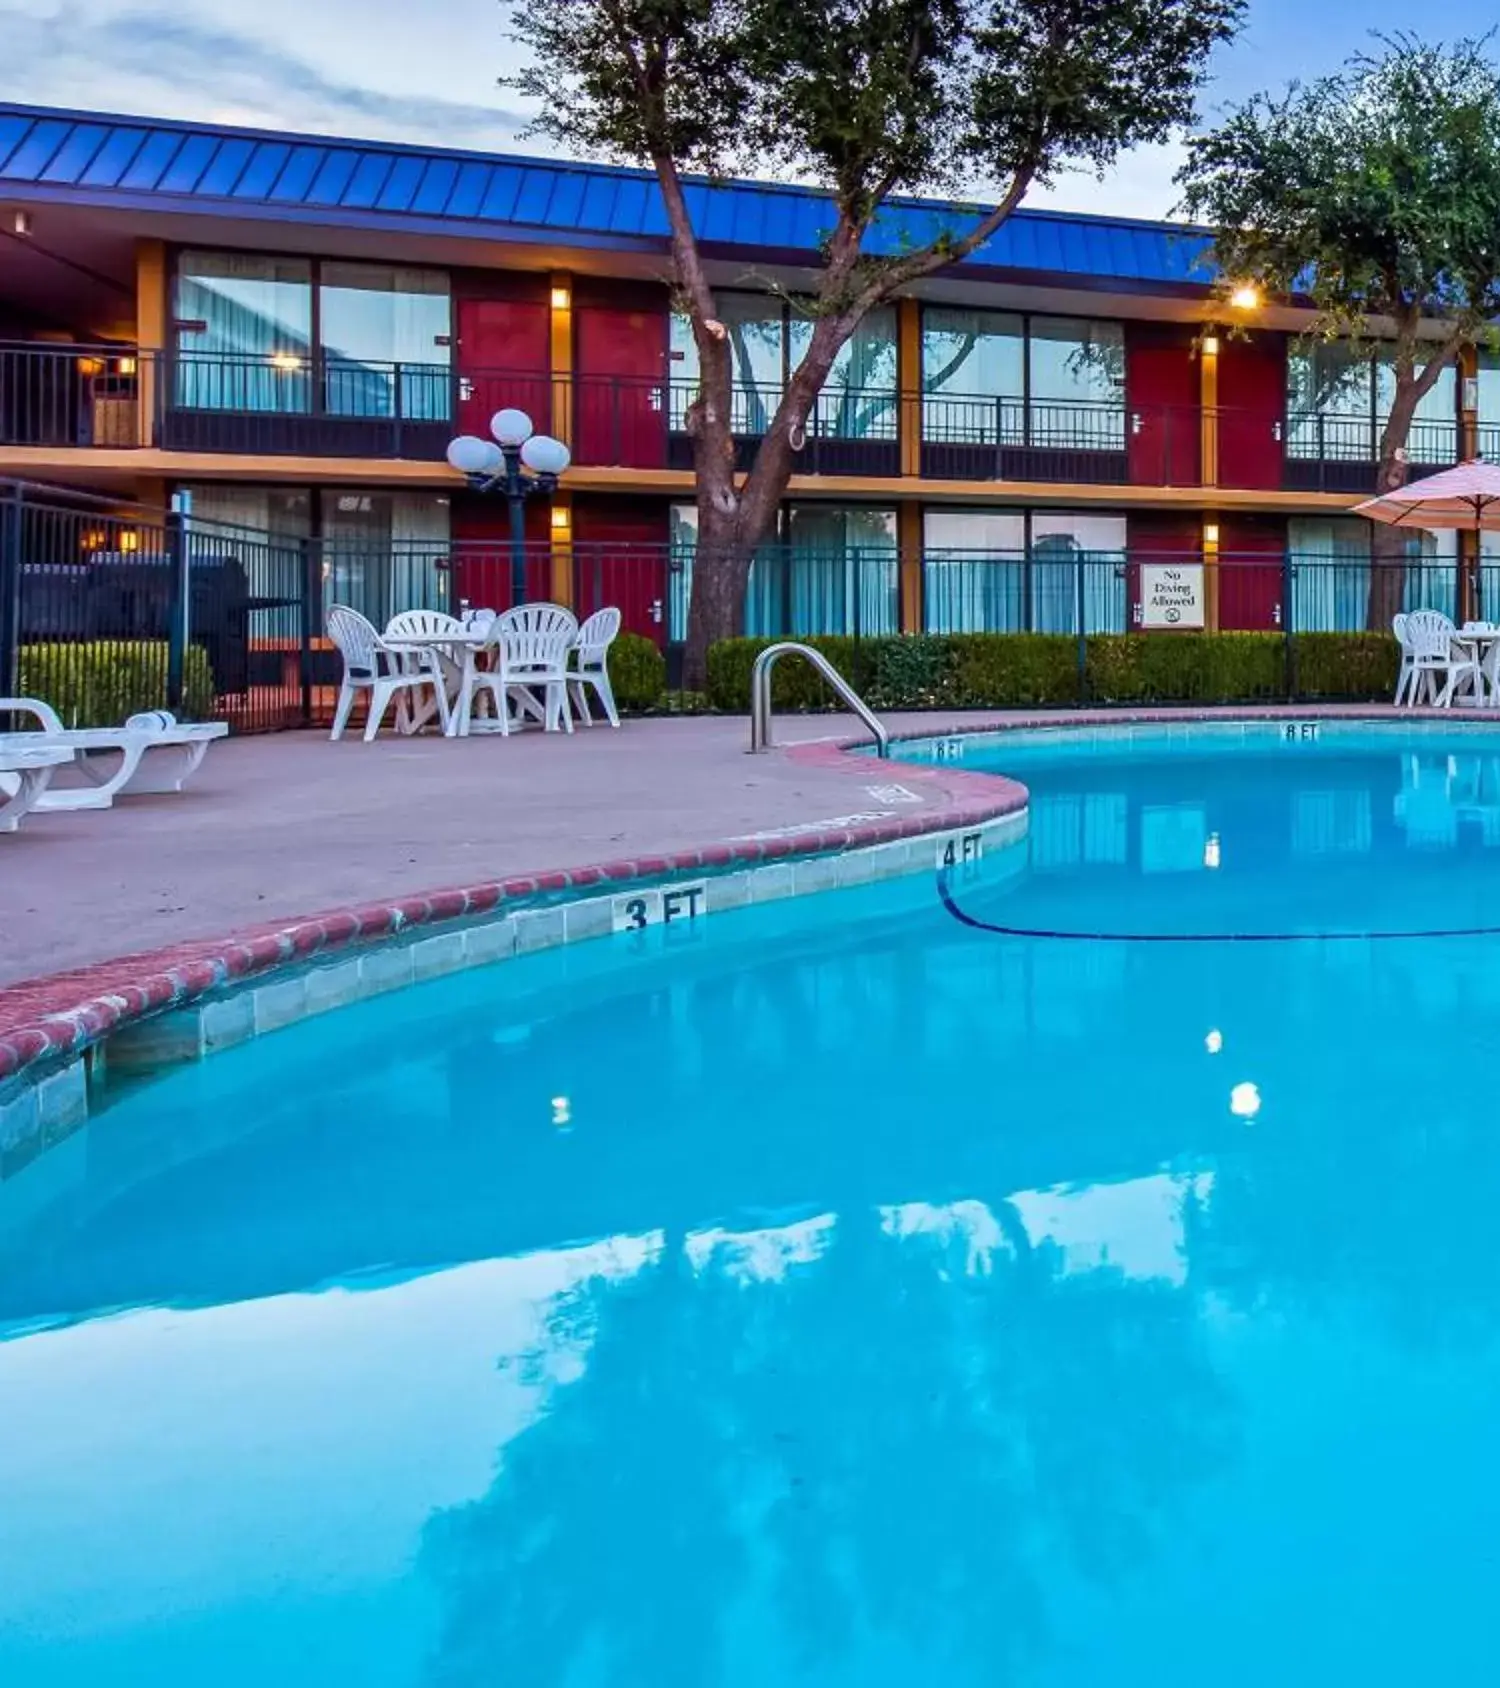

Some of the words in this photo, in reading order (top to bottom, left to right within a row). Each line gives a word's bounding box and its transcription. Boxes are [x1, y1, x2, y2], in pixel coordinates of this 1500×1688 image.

[1163, 571, 1181, 580] No
[1154, 582, 1191, 596] Diving
[1151, 596, 1195, 607] Allowed
[1302, 724, 1317, 740] FT
[943, 839, 956, 865] 4
[963, 833, 982, 862] FT
[625, 899, 647, 931] 3
[663, 887, 703, 923] FT
